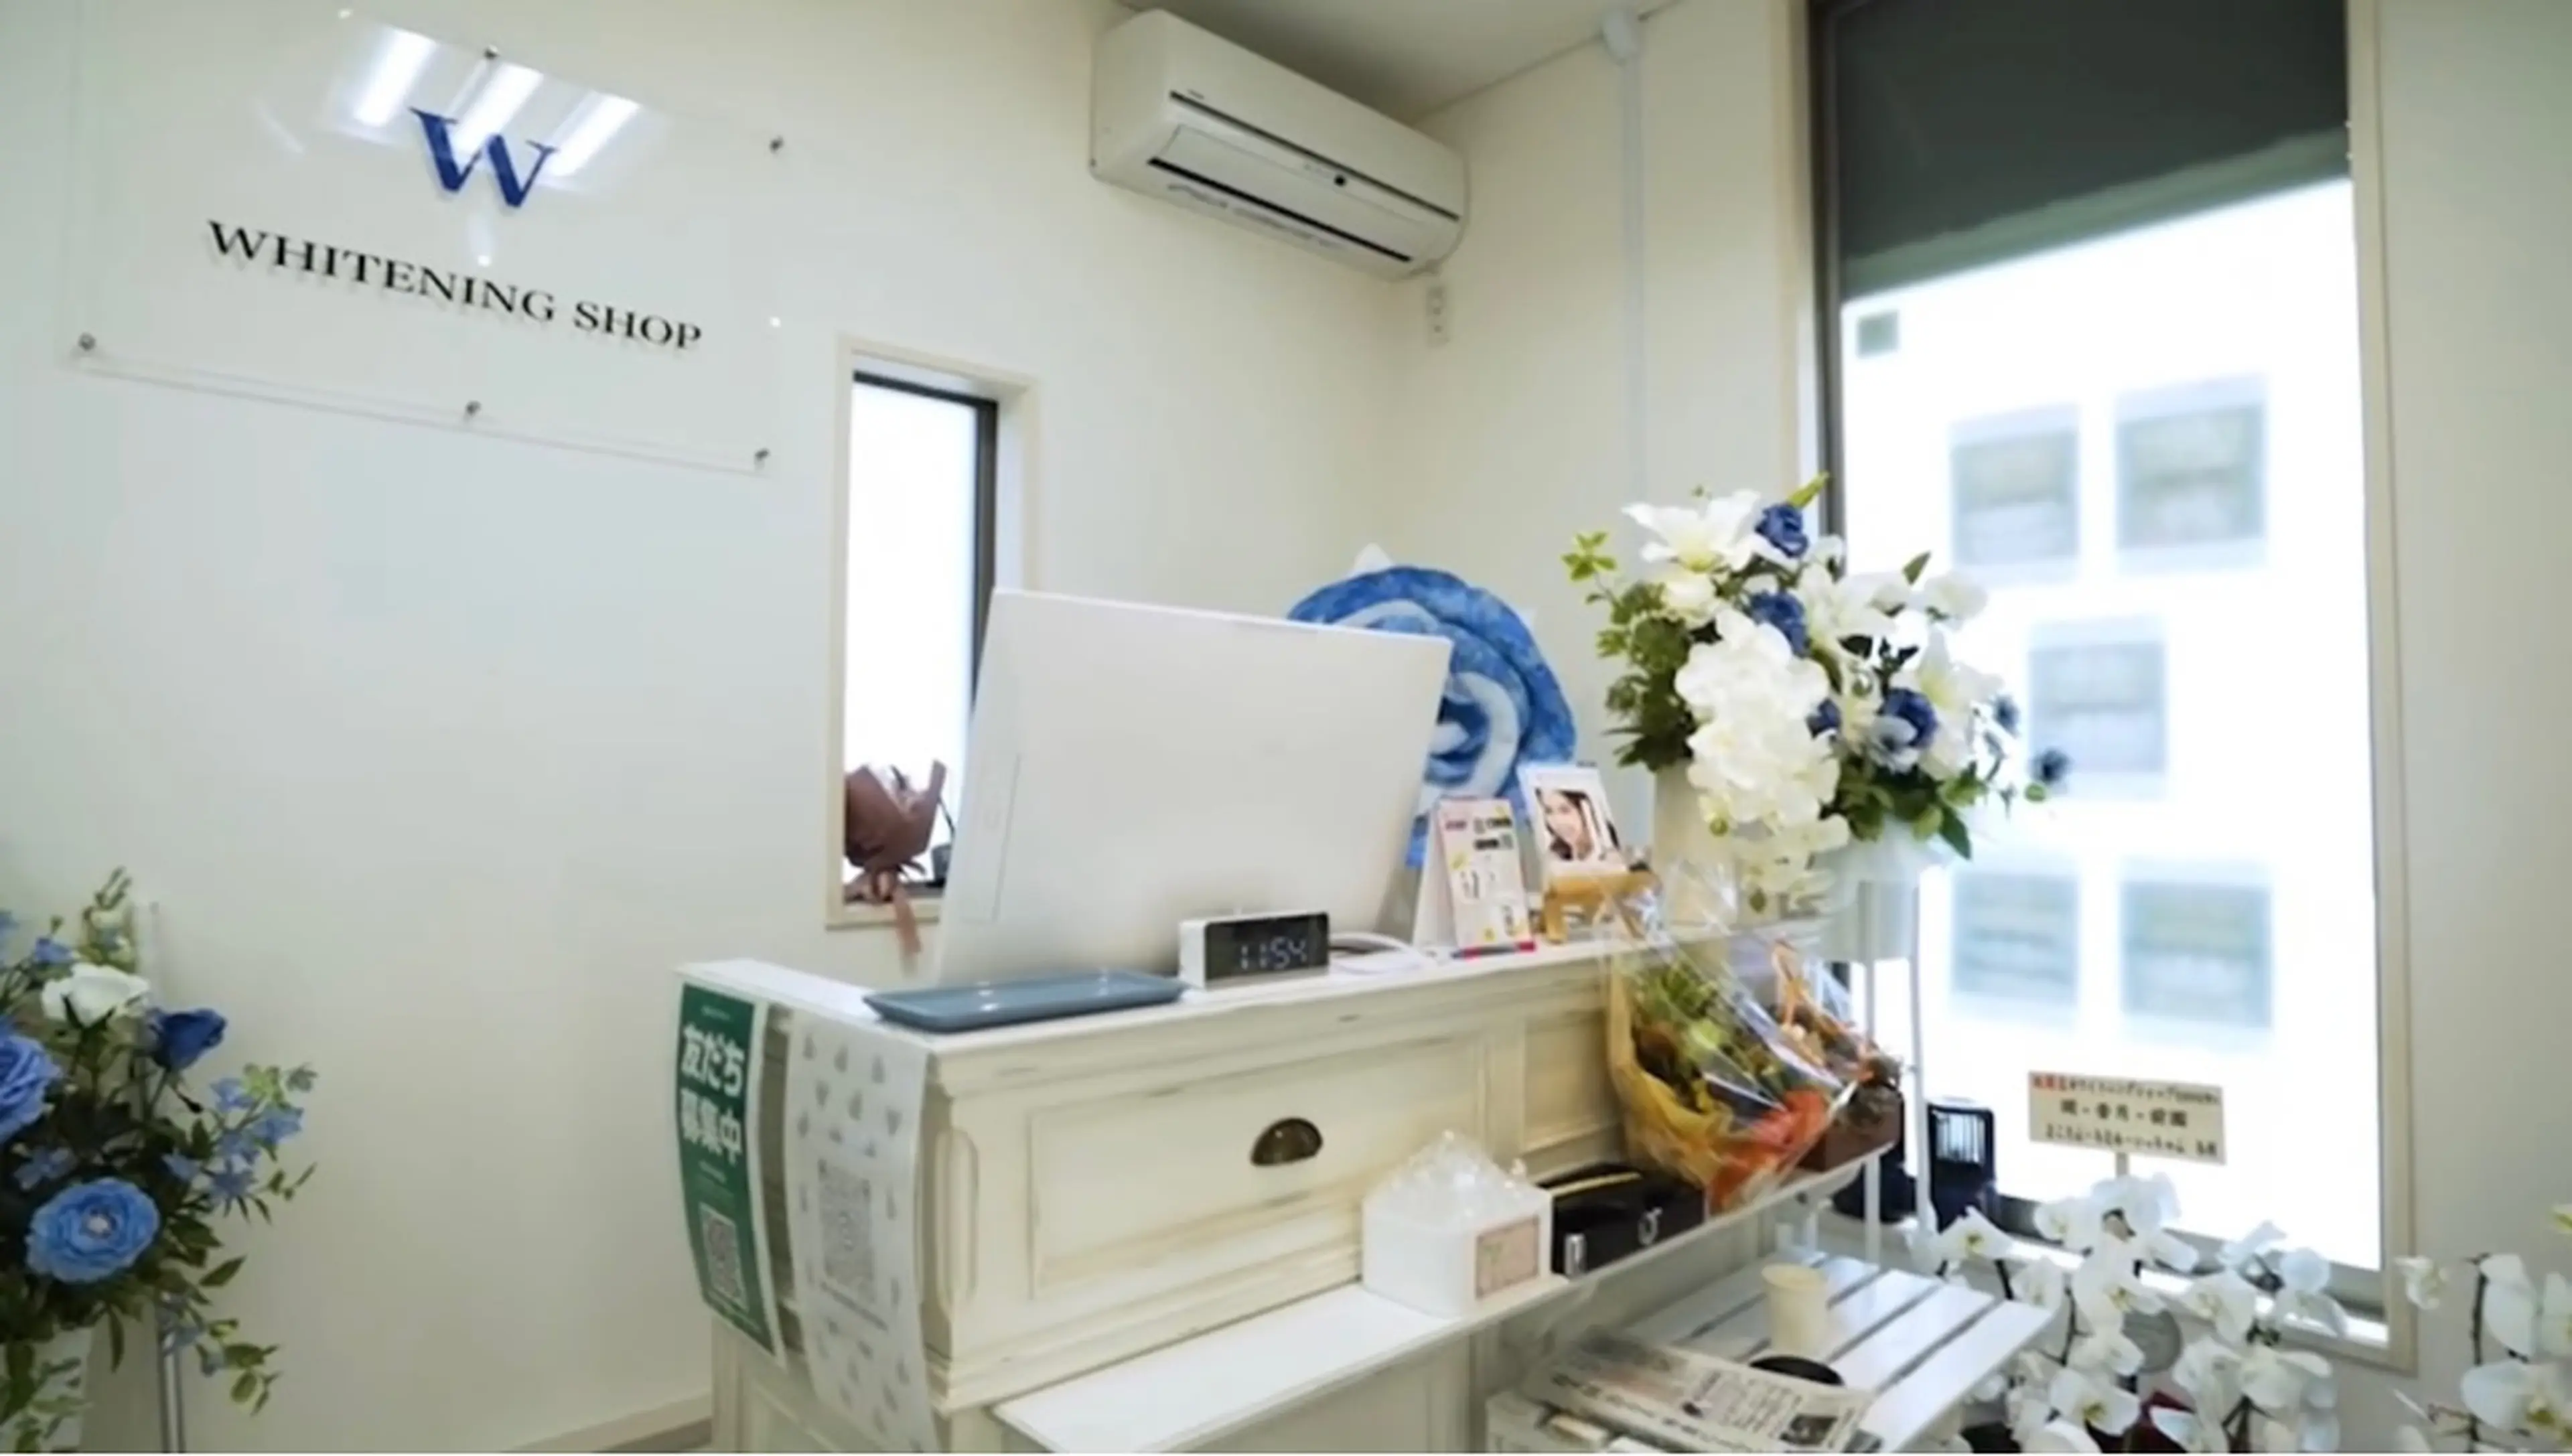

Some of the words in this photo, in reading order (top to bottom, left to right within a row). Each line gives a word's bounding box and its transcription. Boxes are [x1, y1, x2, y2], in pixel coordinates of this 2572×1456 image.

[409, 106, 559, 208] W
[208, 219, 555, 323] WHITENING
[573, 300, 702, 350] SHOP
